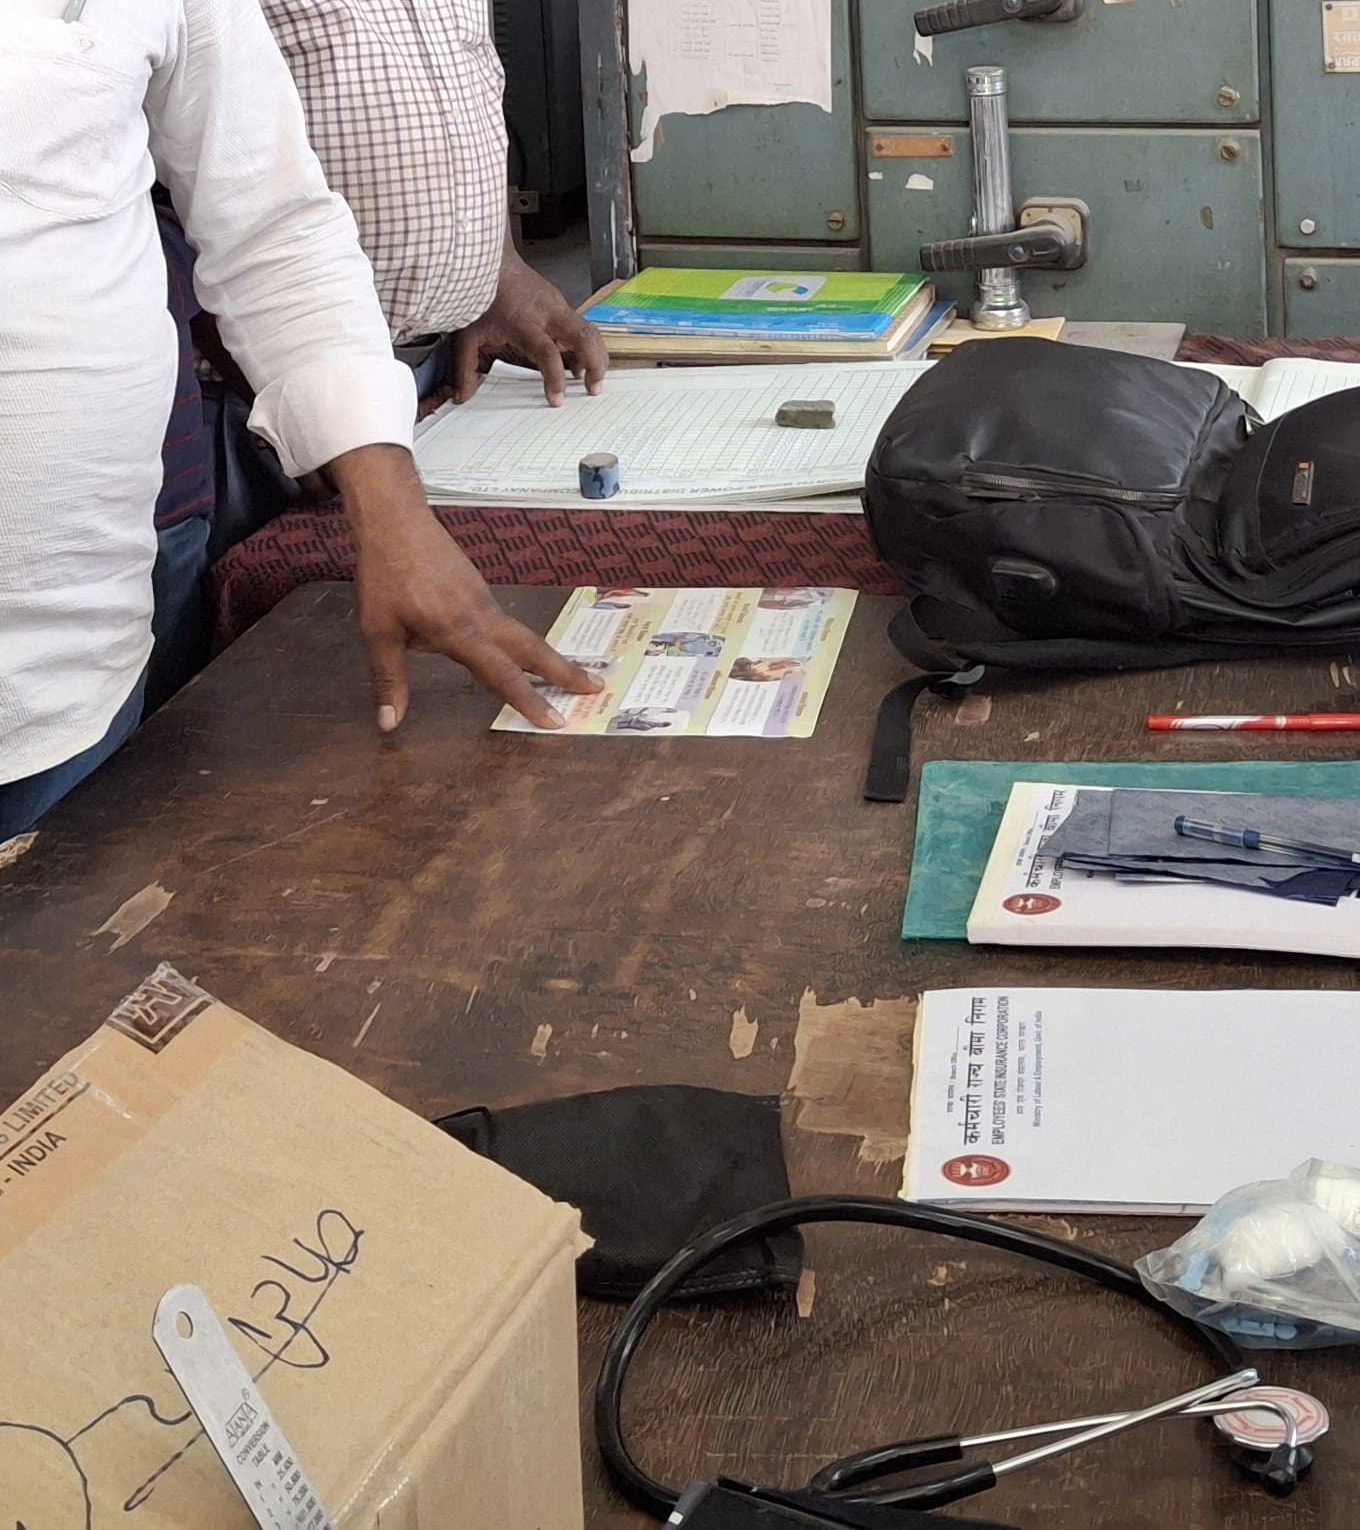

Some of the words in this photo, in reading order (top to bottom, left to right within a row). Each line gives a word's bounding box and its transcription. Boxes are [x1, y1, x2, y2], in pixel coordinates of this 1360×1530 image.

[619, 487, 685, 496] DISTRIBU
[964, 996, 987, 1026] निगम
[995, 995, 1010, 1041] CORPORATION
[962, 1030, 985, 1057] बीमा
[994, 1041, 1009, 1079] INSURANCE
[967, 1062, 985, 1089] राज्य
[993, 1078, 1007, 1099] STATE
[3, 1071, 80, 1134] LIMITED
[957, 1093, 983, 1146] कर्मचारी
[6, 1129, 68, 1177] INDIA
[236, 1421, 271, 1465] CONVERSION
[251, 1443, 271, 1468] TABLE
